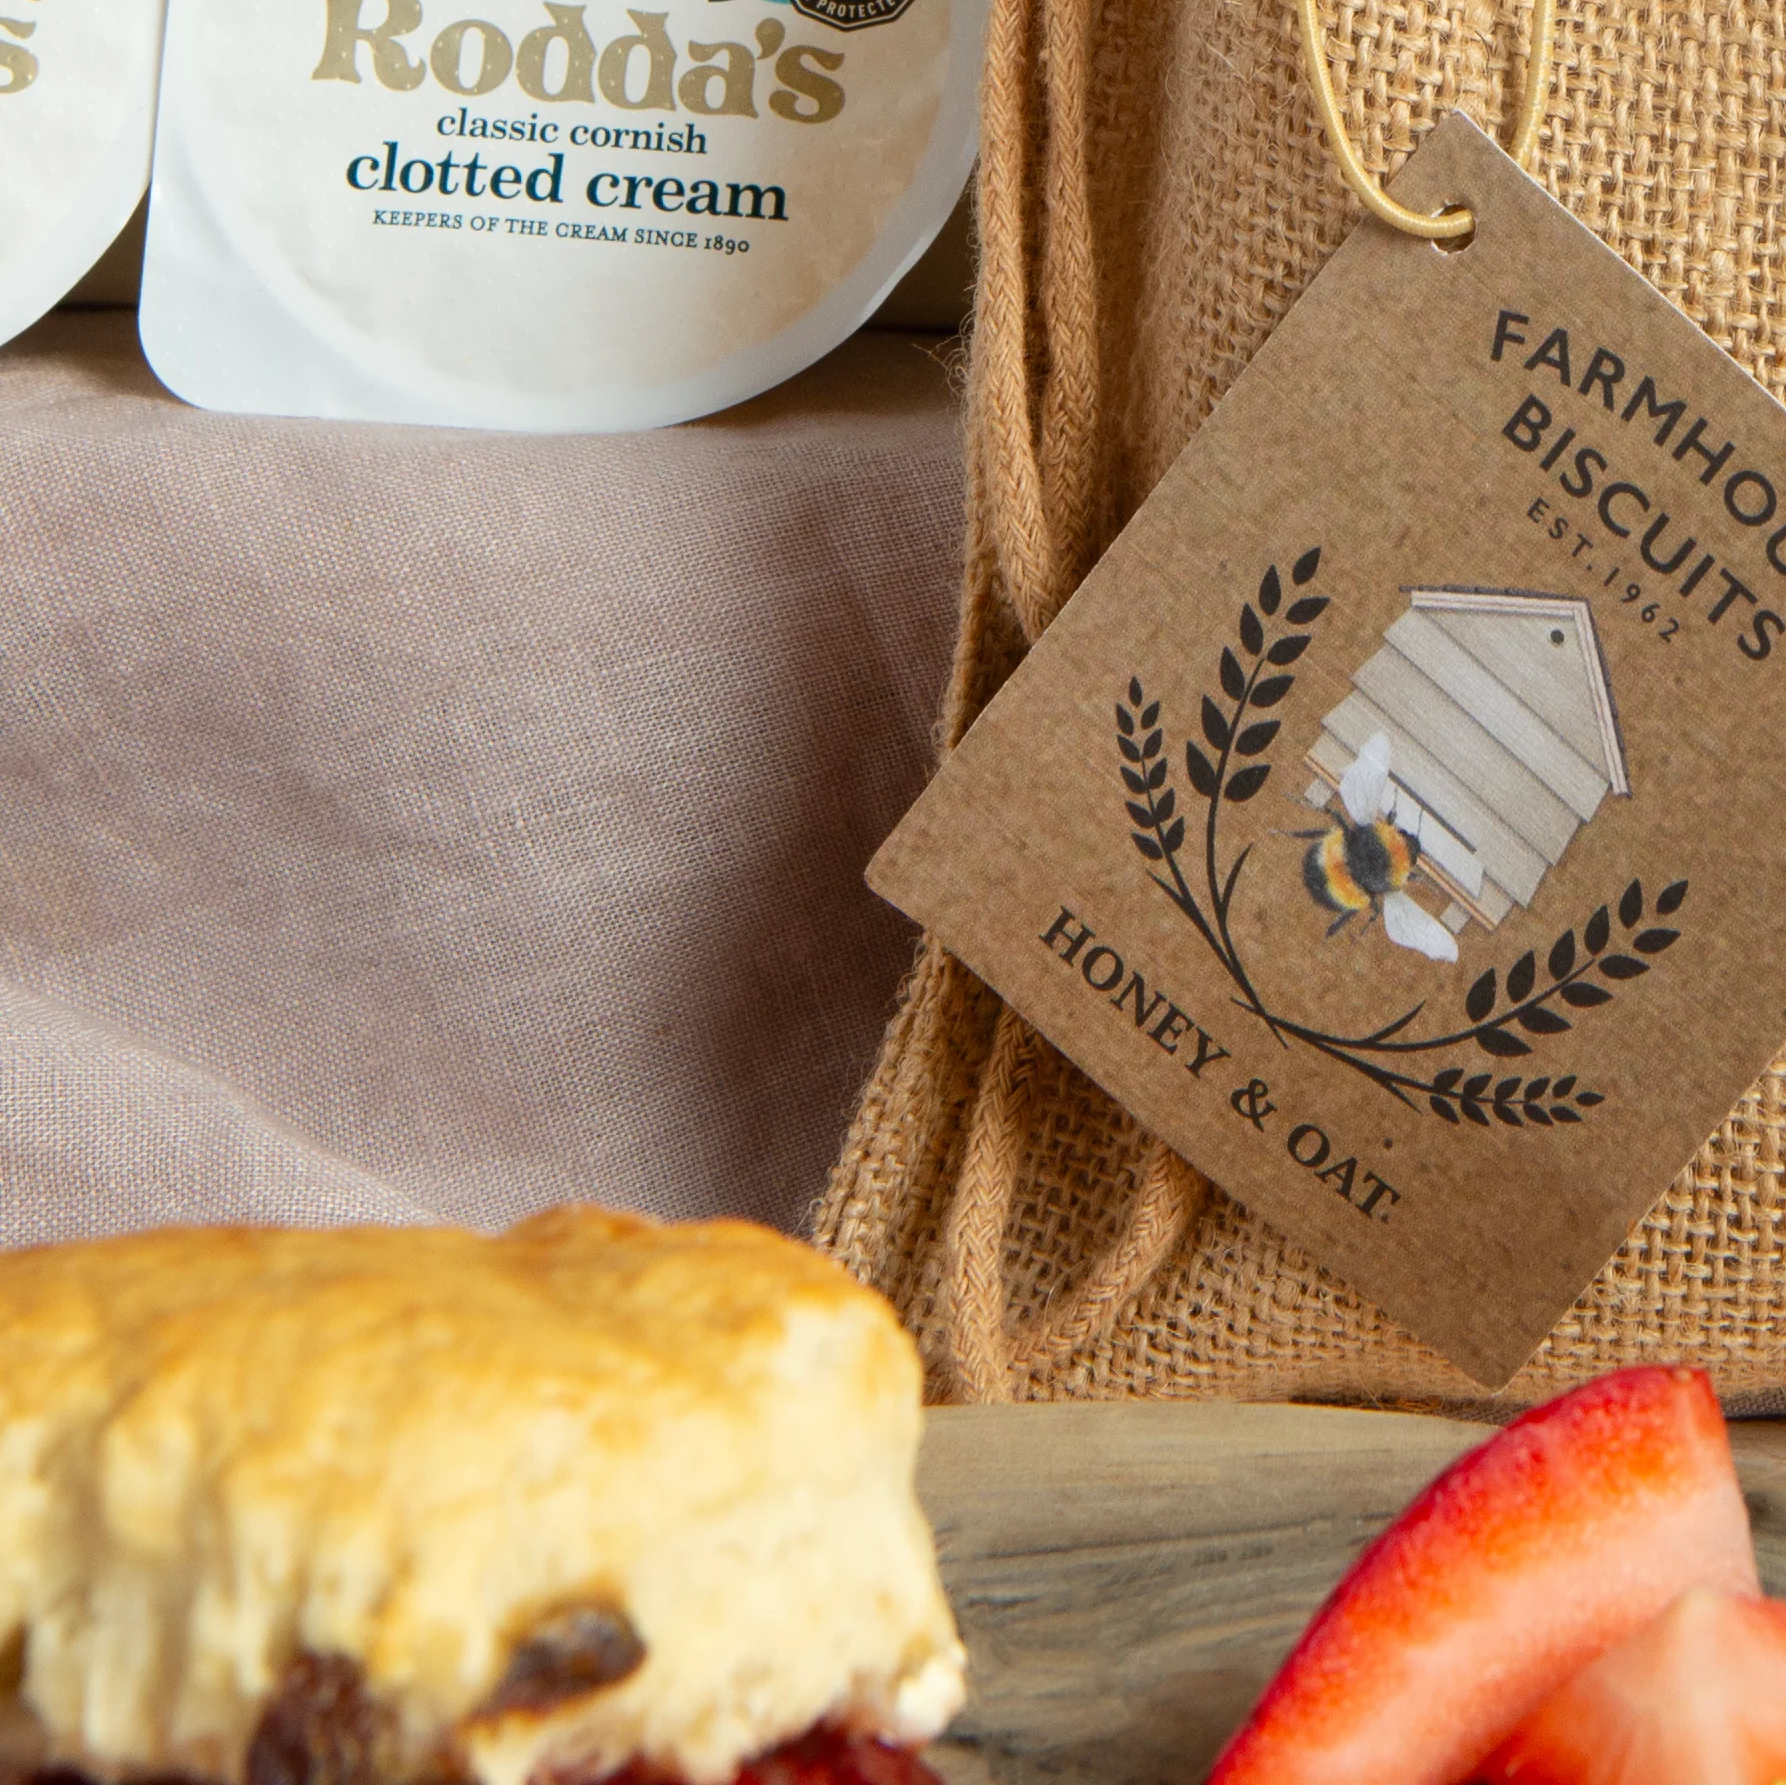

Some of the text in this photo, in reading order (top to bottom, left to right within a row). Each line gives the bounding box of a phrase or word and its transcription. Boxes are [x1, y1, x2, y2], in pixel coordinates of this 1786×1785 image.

[436, 107, 708, 155] classic cornish
[346, 141, 789, 222] clotted cream
[373, 210, 751, 256] KEEPERS OF THE CREAM SINCE 1890
[1502, 394, 1786, 661] BISCUITS
[1038, 905, 1231, 1079] HONEY
[1230, 1078, 1277, 1133] &
